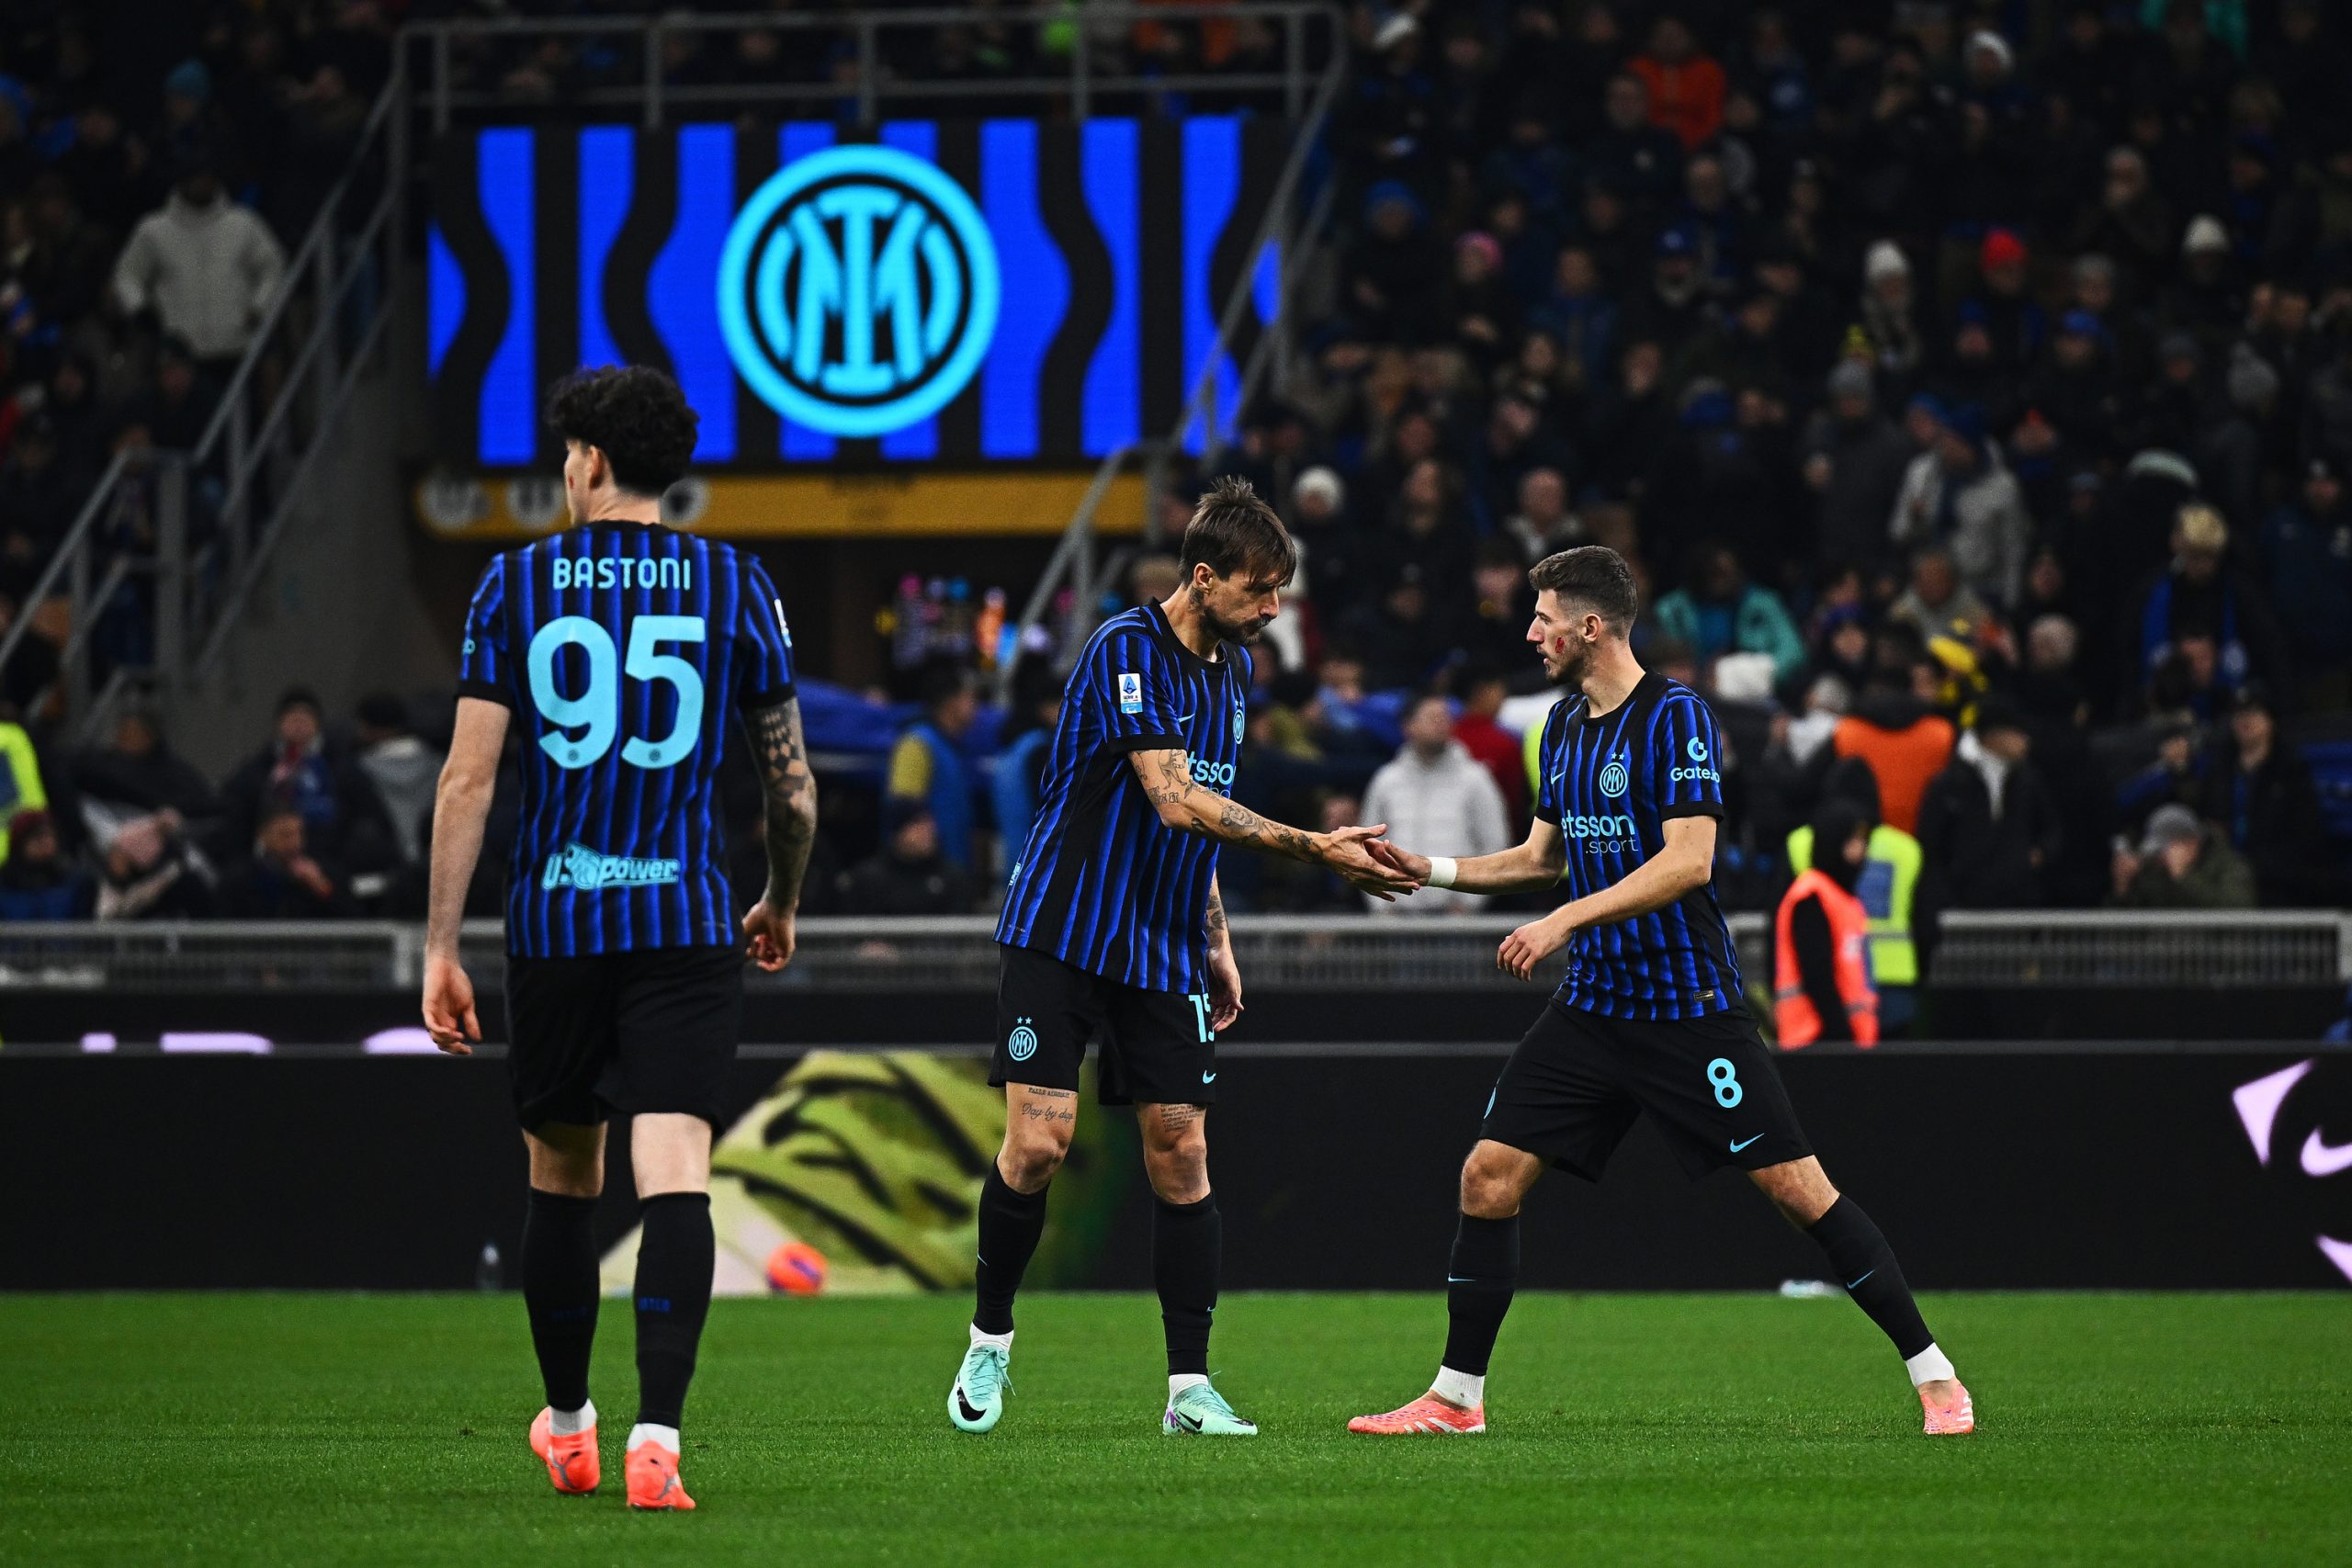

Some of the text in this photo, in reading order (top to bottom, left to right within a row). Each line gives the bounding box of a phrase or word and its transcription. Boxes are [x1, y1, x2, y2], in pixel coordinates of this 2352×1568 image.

[552, 557, 691, 590] BASTONI
[527, 615, 706, 769] 95
[1187, 750, 1236, 785] tsso
[1670, 766, 1720, 784] Gate.io
[1707, 1057, 1743, 1109] 8
[1022, 1102, 1043, 1120] Day
[1045, 1105, 1057, 1122] by
